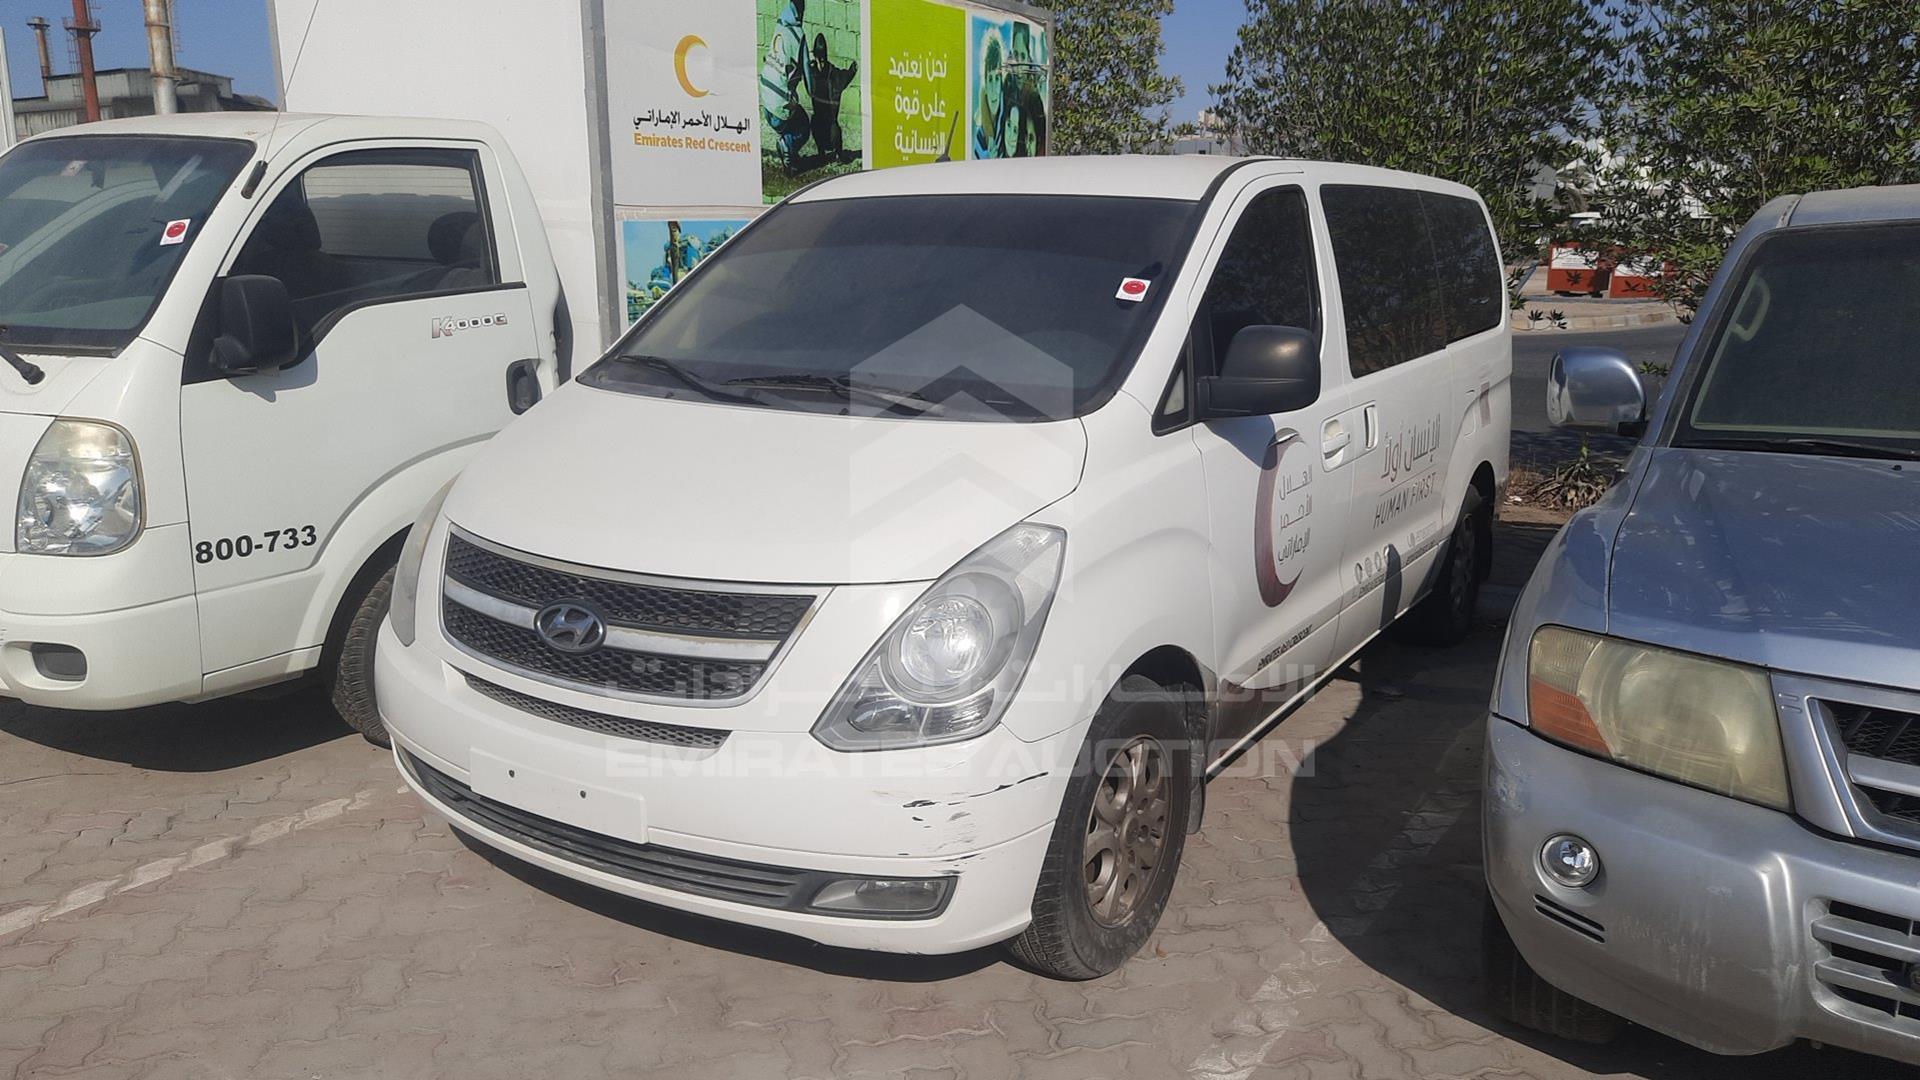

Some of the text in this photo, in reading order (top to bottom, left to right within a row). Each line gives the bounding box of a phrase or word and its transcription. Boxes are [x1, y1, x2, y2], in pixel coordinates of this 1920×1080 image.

[889, 51, 947, 82] نحن نعتمد
[895, 86, 920, 120] قوة
[713, 114, 750, 134] الهلال
[634, 132, 751, 153] Emirates Red Crescent
[1373, 472, 1436, 529] HUMAN FIRST
[195, 524, 317, 563] 800-733
